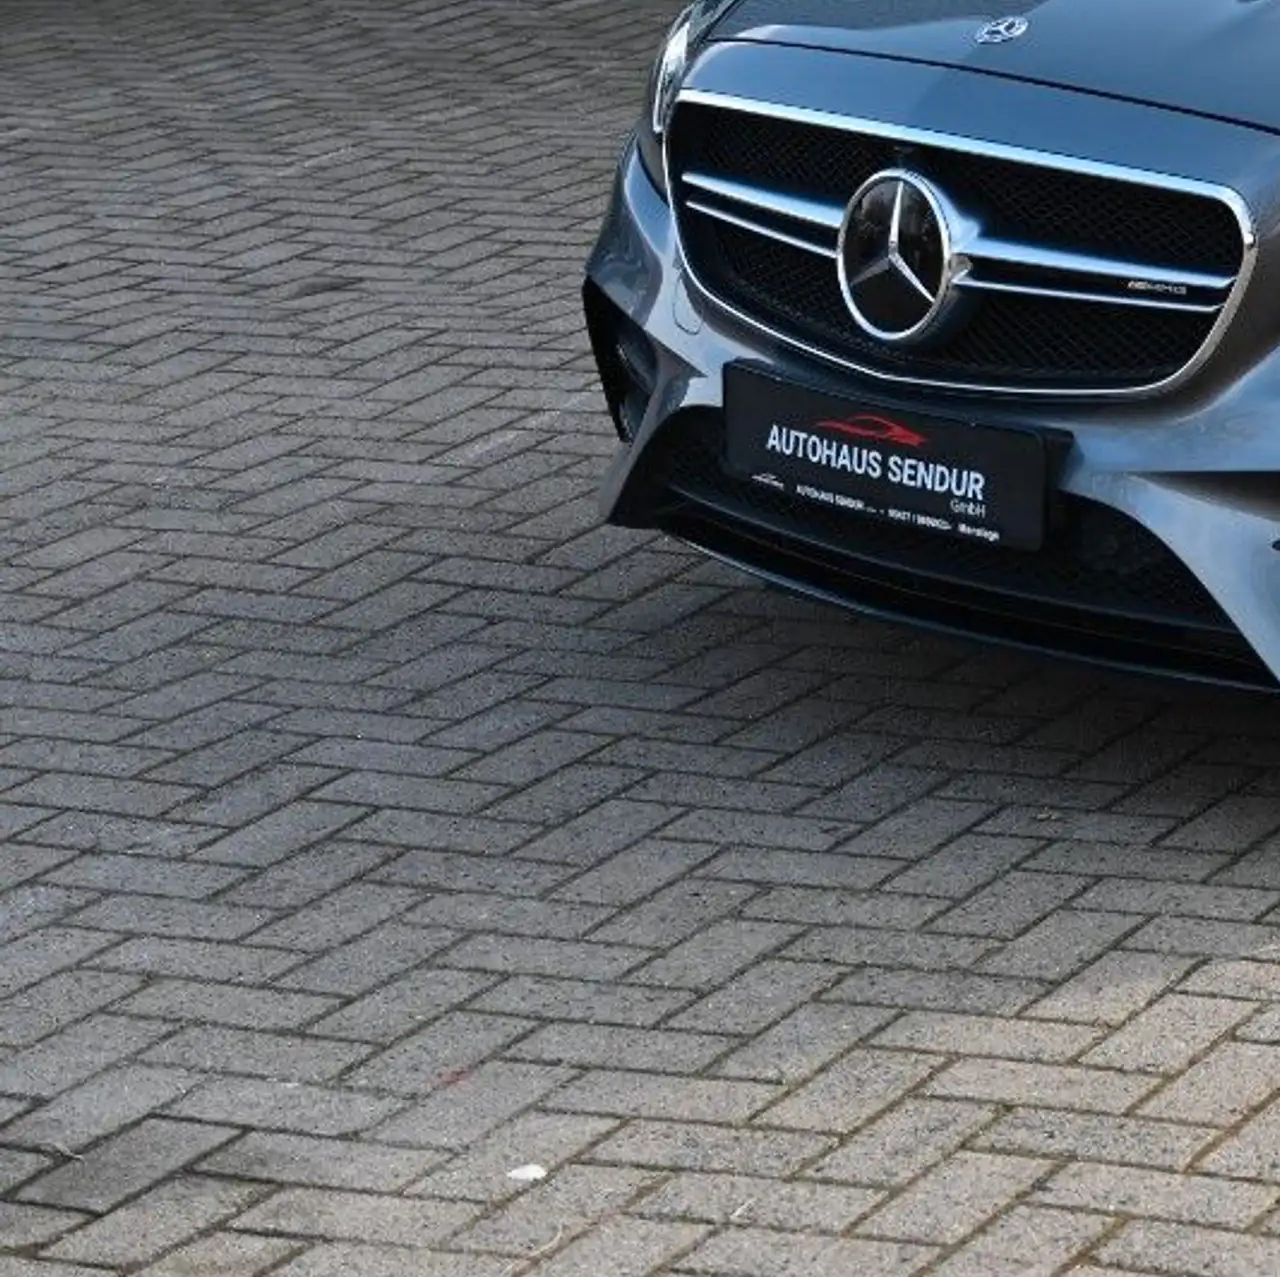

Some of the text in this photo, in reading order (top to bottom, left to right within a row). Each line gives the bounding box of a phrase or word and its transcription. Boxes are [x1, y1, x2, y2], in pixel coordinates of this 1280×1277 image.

[765, 424, 986, 501] AUTOHAUS SENDUR
[950, 498, 986, 519] GmbH
